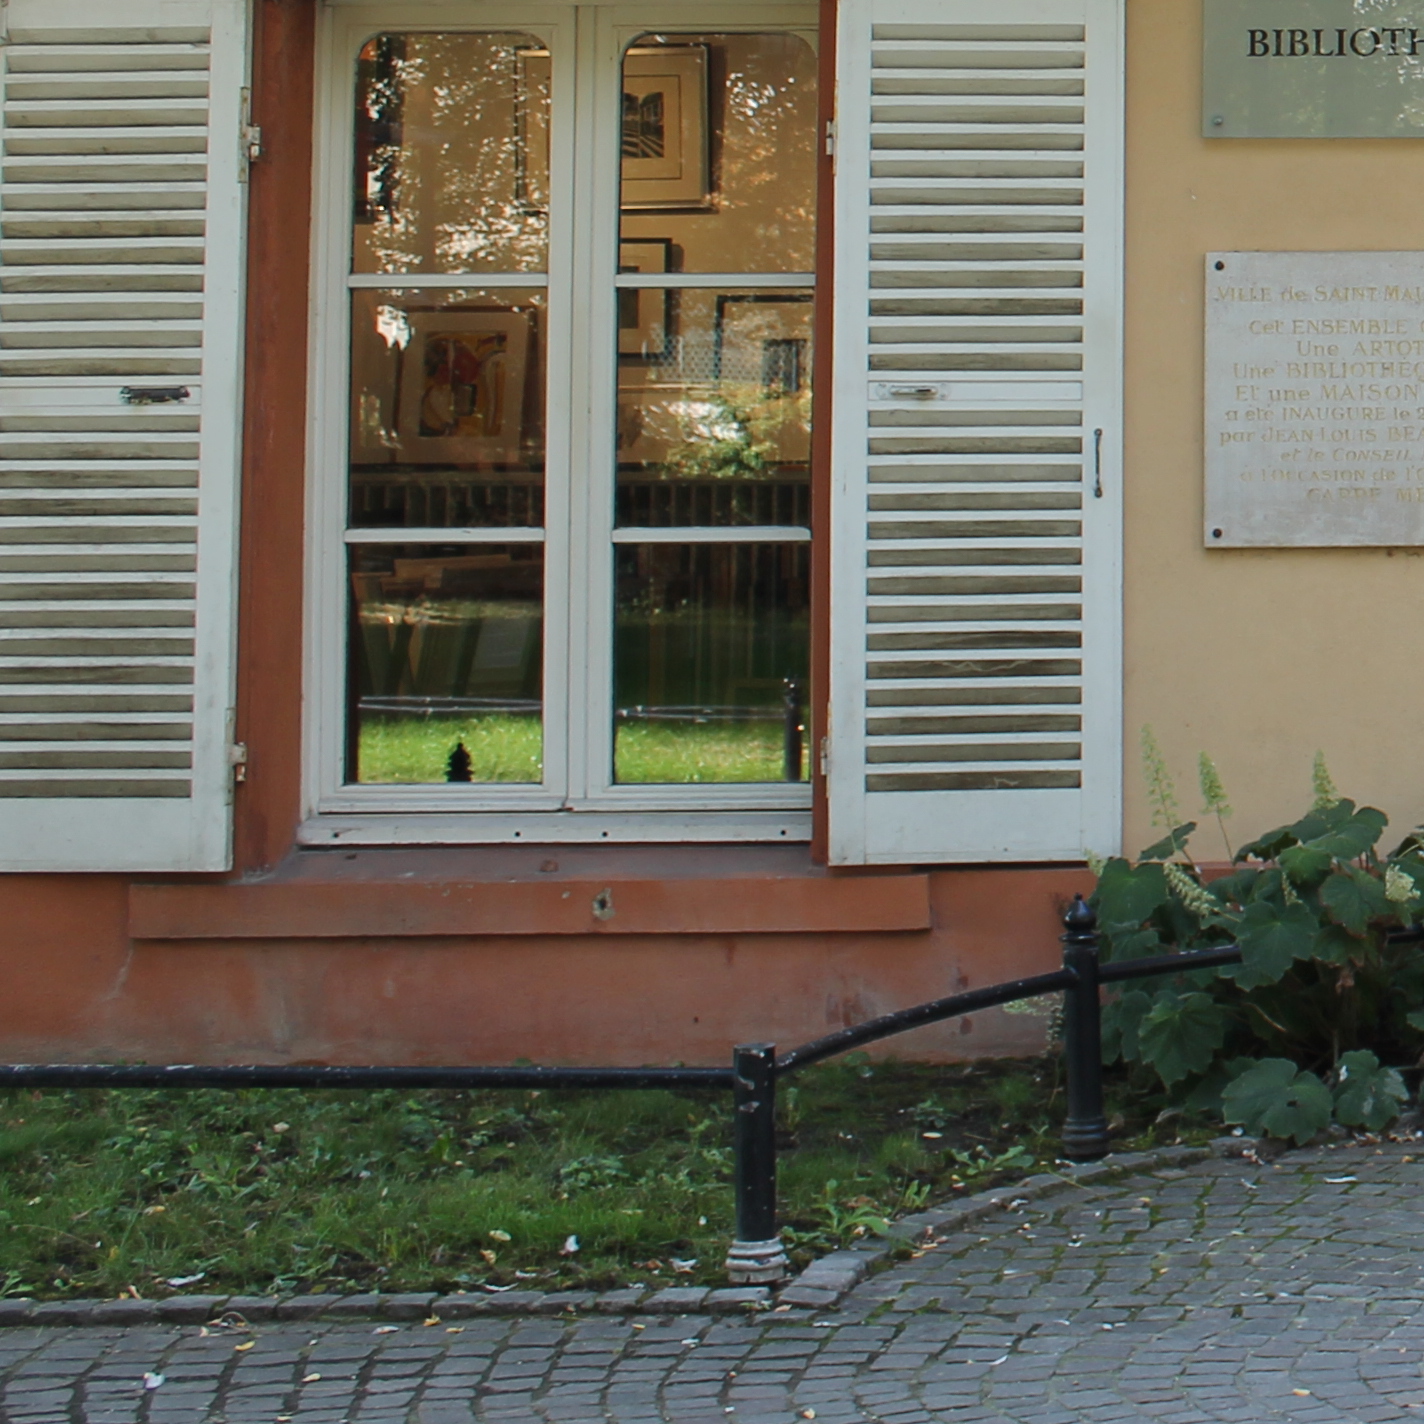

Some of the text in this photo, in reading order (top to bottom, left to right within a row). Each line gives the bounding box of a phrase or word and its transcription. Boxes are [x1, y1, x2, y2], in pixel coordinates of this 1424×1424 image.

[1216, 285, 1272, 303] VILLE
[1280, 285, 1307, 302] de
[1248, 319, 1285, 336] Cet
[1291, 319, 1408, 335] ENSEMBLE
[1295, 340, 1340, 357] Une
[1233, 361, 1276, 379] Une
[1235, 384, 1261, 402] Et
[1268, 387, 1311, 402] une
[1320, 384, 1420, 401] MAISON
[1392, 406, 1411, 421] le
[1219, 430, 1256, 447] par
[1280, 448, 1302, 462] et
[1307, 448, 1326, 462] le
[1332, 447, 1413, 461] CONSEIL
[1372, 467, 1398, 482] de
